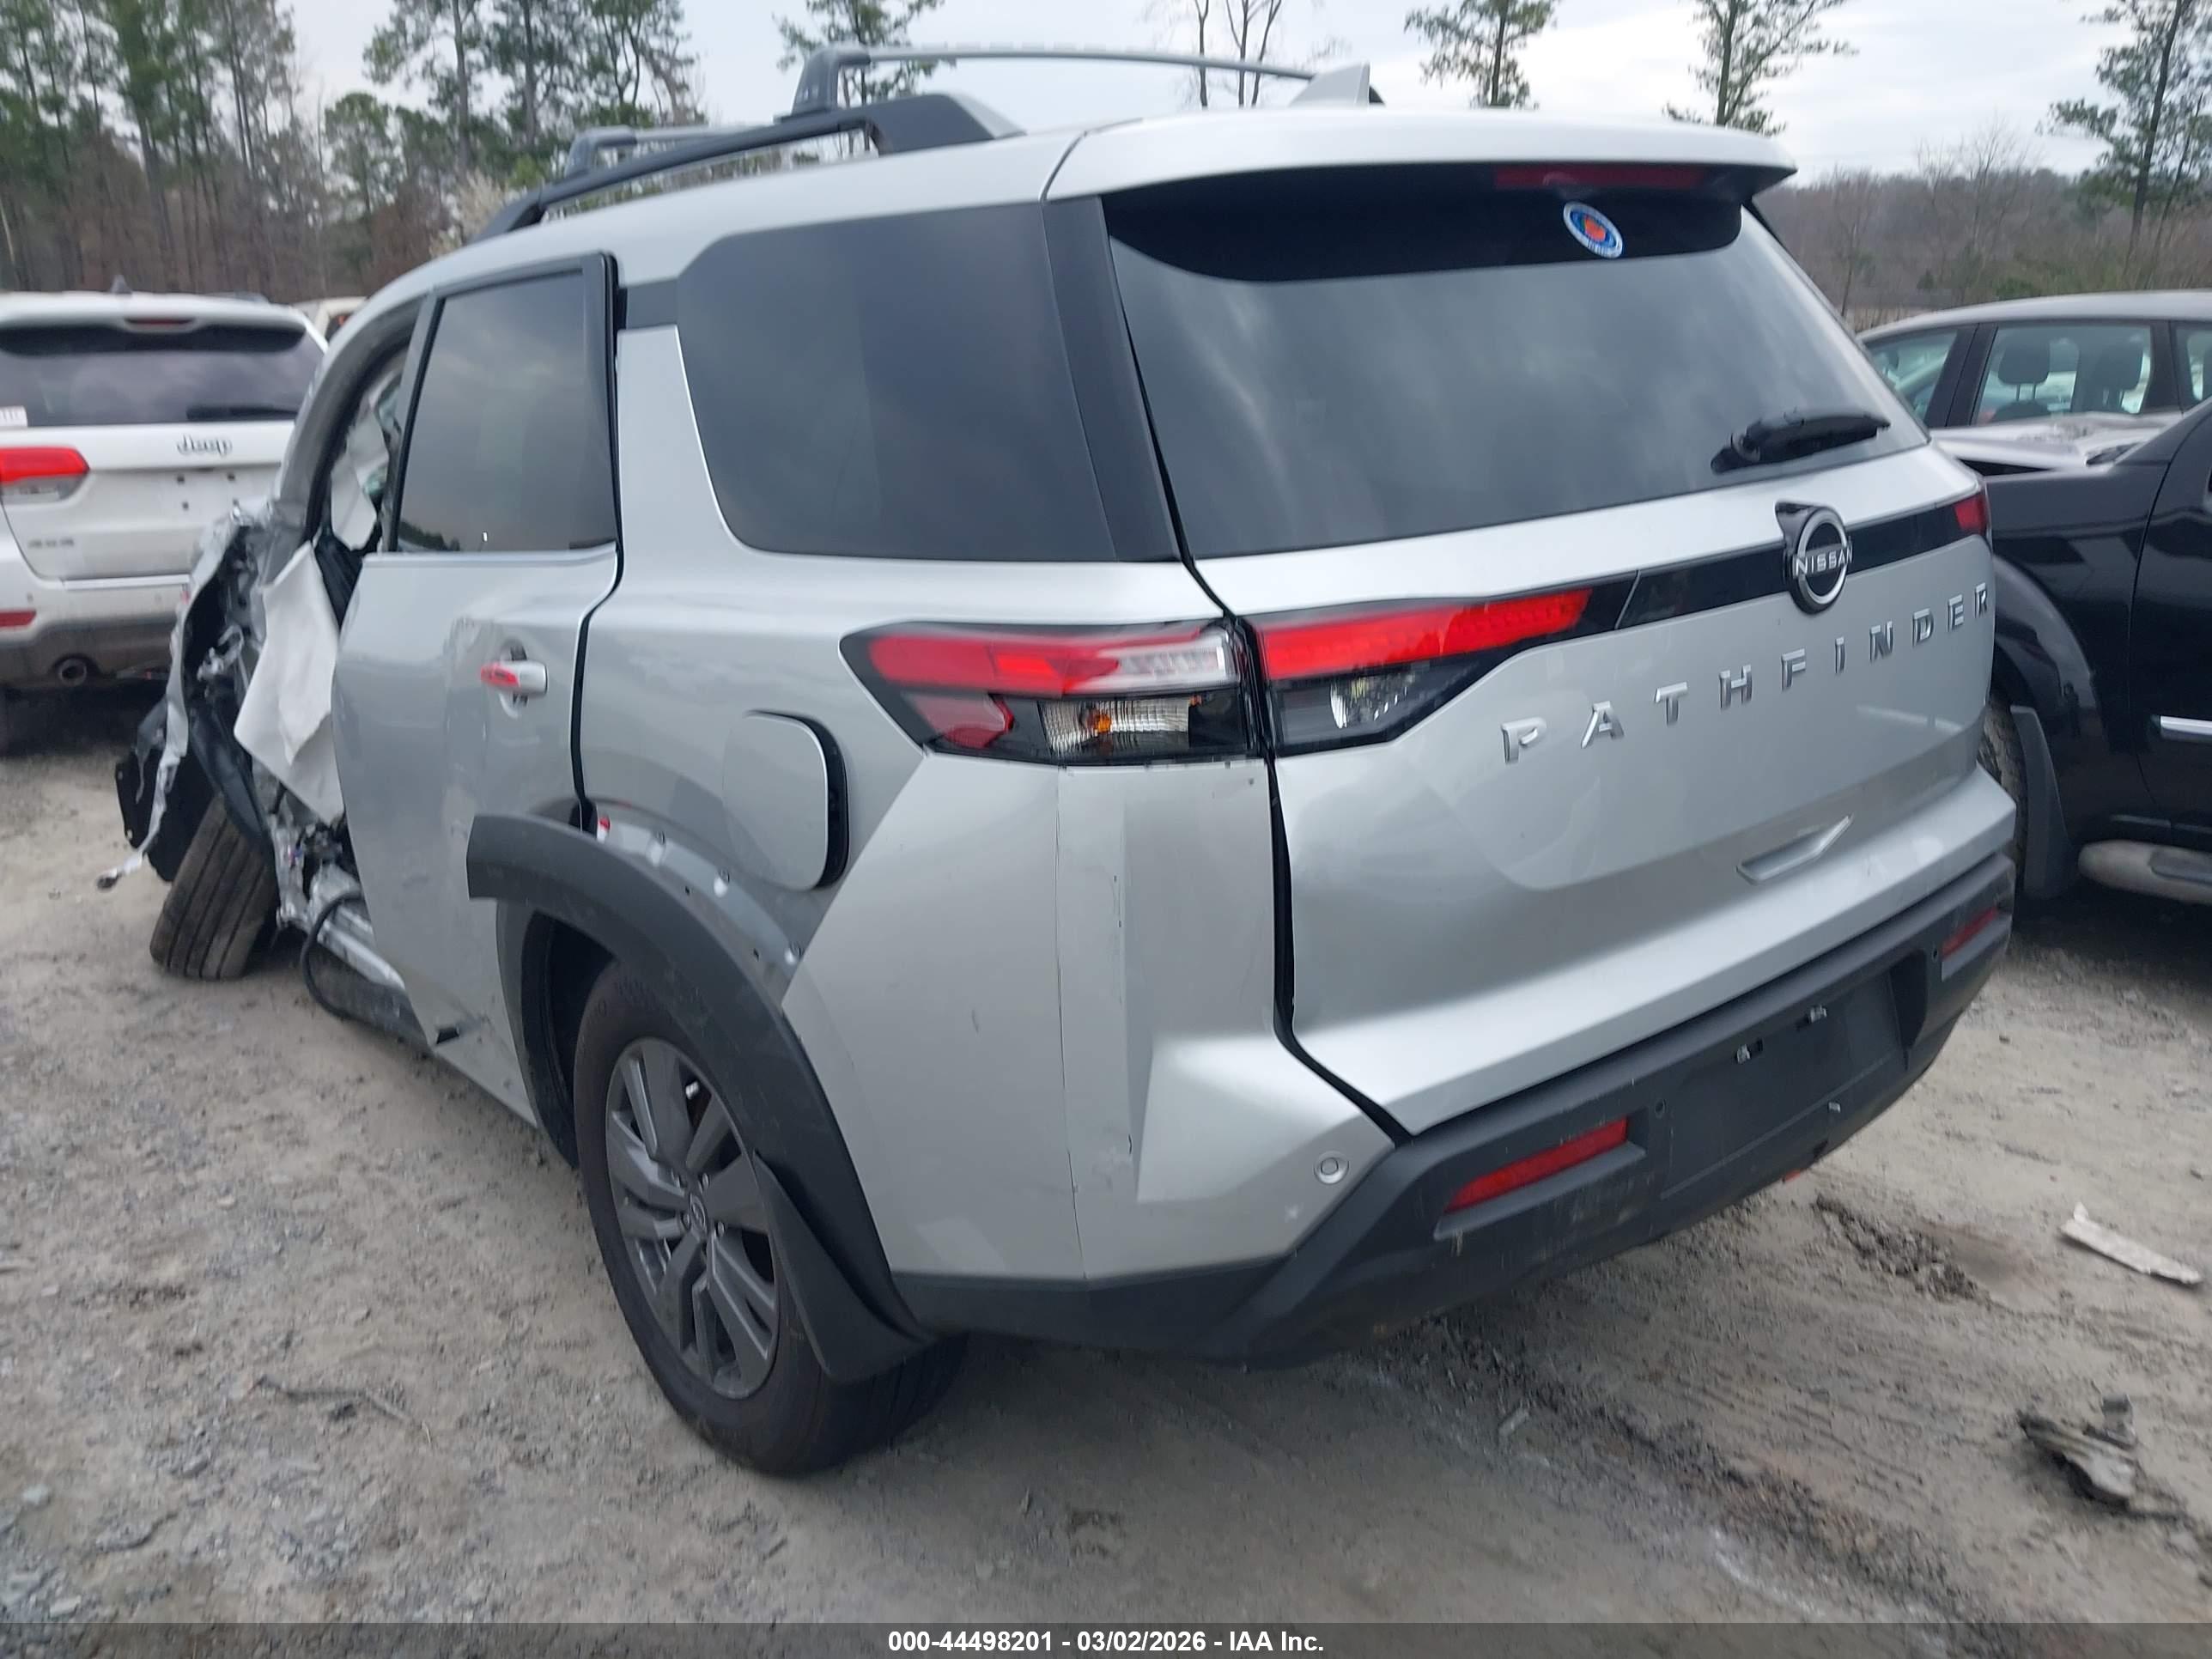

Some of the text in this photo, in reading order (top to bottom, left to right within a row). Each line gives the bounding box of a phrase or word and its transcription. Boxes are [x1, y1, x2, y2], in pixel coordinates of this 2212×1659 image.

[177, 434, 233, 457] Jeep
[1794, 538, 1852, 577] NISSAN
[1501, 581, 1987, 763] PATHFINDER
